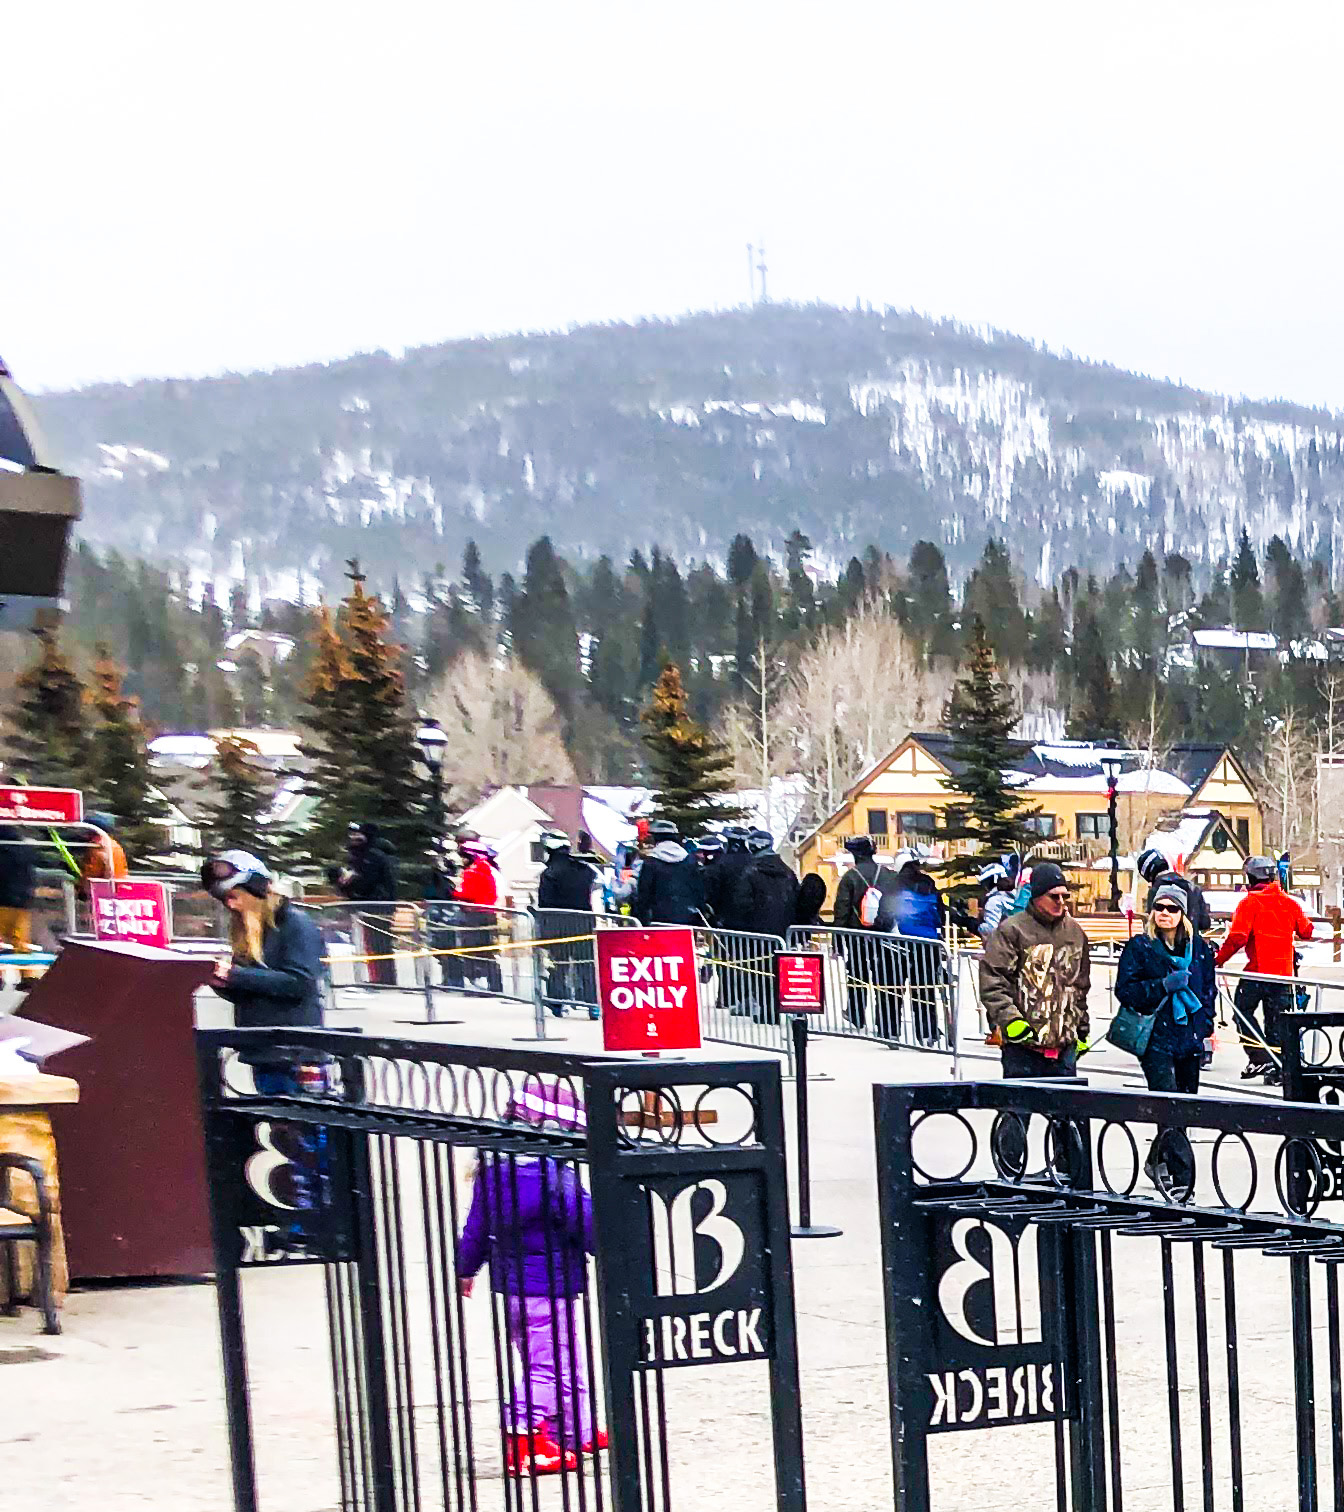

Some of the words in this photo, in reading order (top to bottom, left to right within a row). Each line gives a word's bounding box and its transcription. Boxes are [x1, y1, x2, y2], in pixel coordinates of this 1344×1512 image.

[97, 897, 157, 917] EXIT
[610, 956, 684, 983] EXIT
[609, 985, 688, 1010] ONLY
